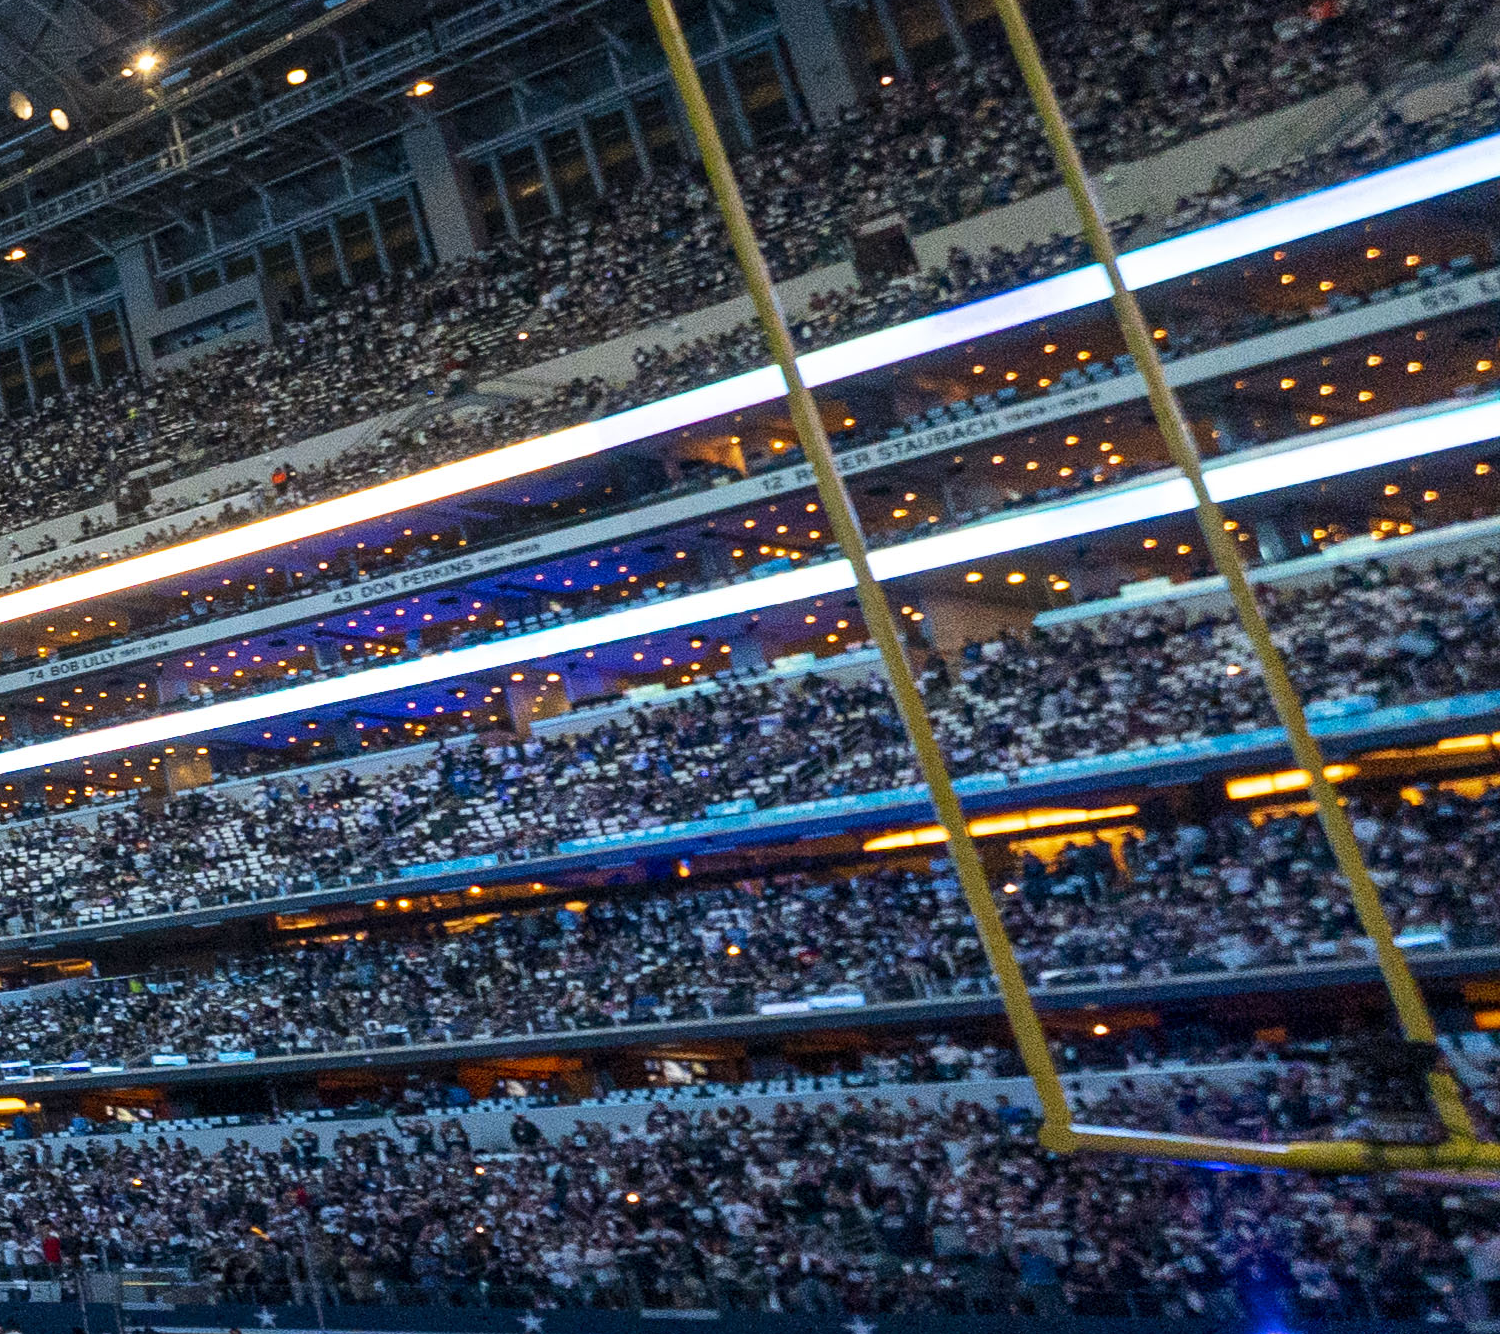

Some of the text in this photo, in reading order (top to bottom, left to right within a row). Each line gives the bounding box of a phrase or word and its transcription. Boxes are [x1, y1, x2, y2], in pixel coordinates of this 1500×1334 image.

[761, 475, 784, 493] 12
[795, 451, 871, 485] RER
[876, 415, 998, 460] STAUBACH
[332, 588, 354, 604] 43
[360, 578, 397, 598] DON
[400, 558, 474, 587] PERKINS
[28, 670, 45, 682] 74
[50, 660, 80, 676] BOB
[82, 651, 116, 668] LILLY
